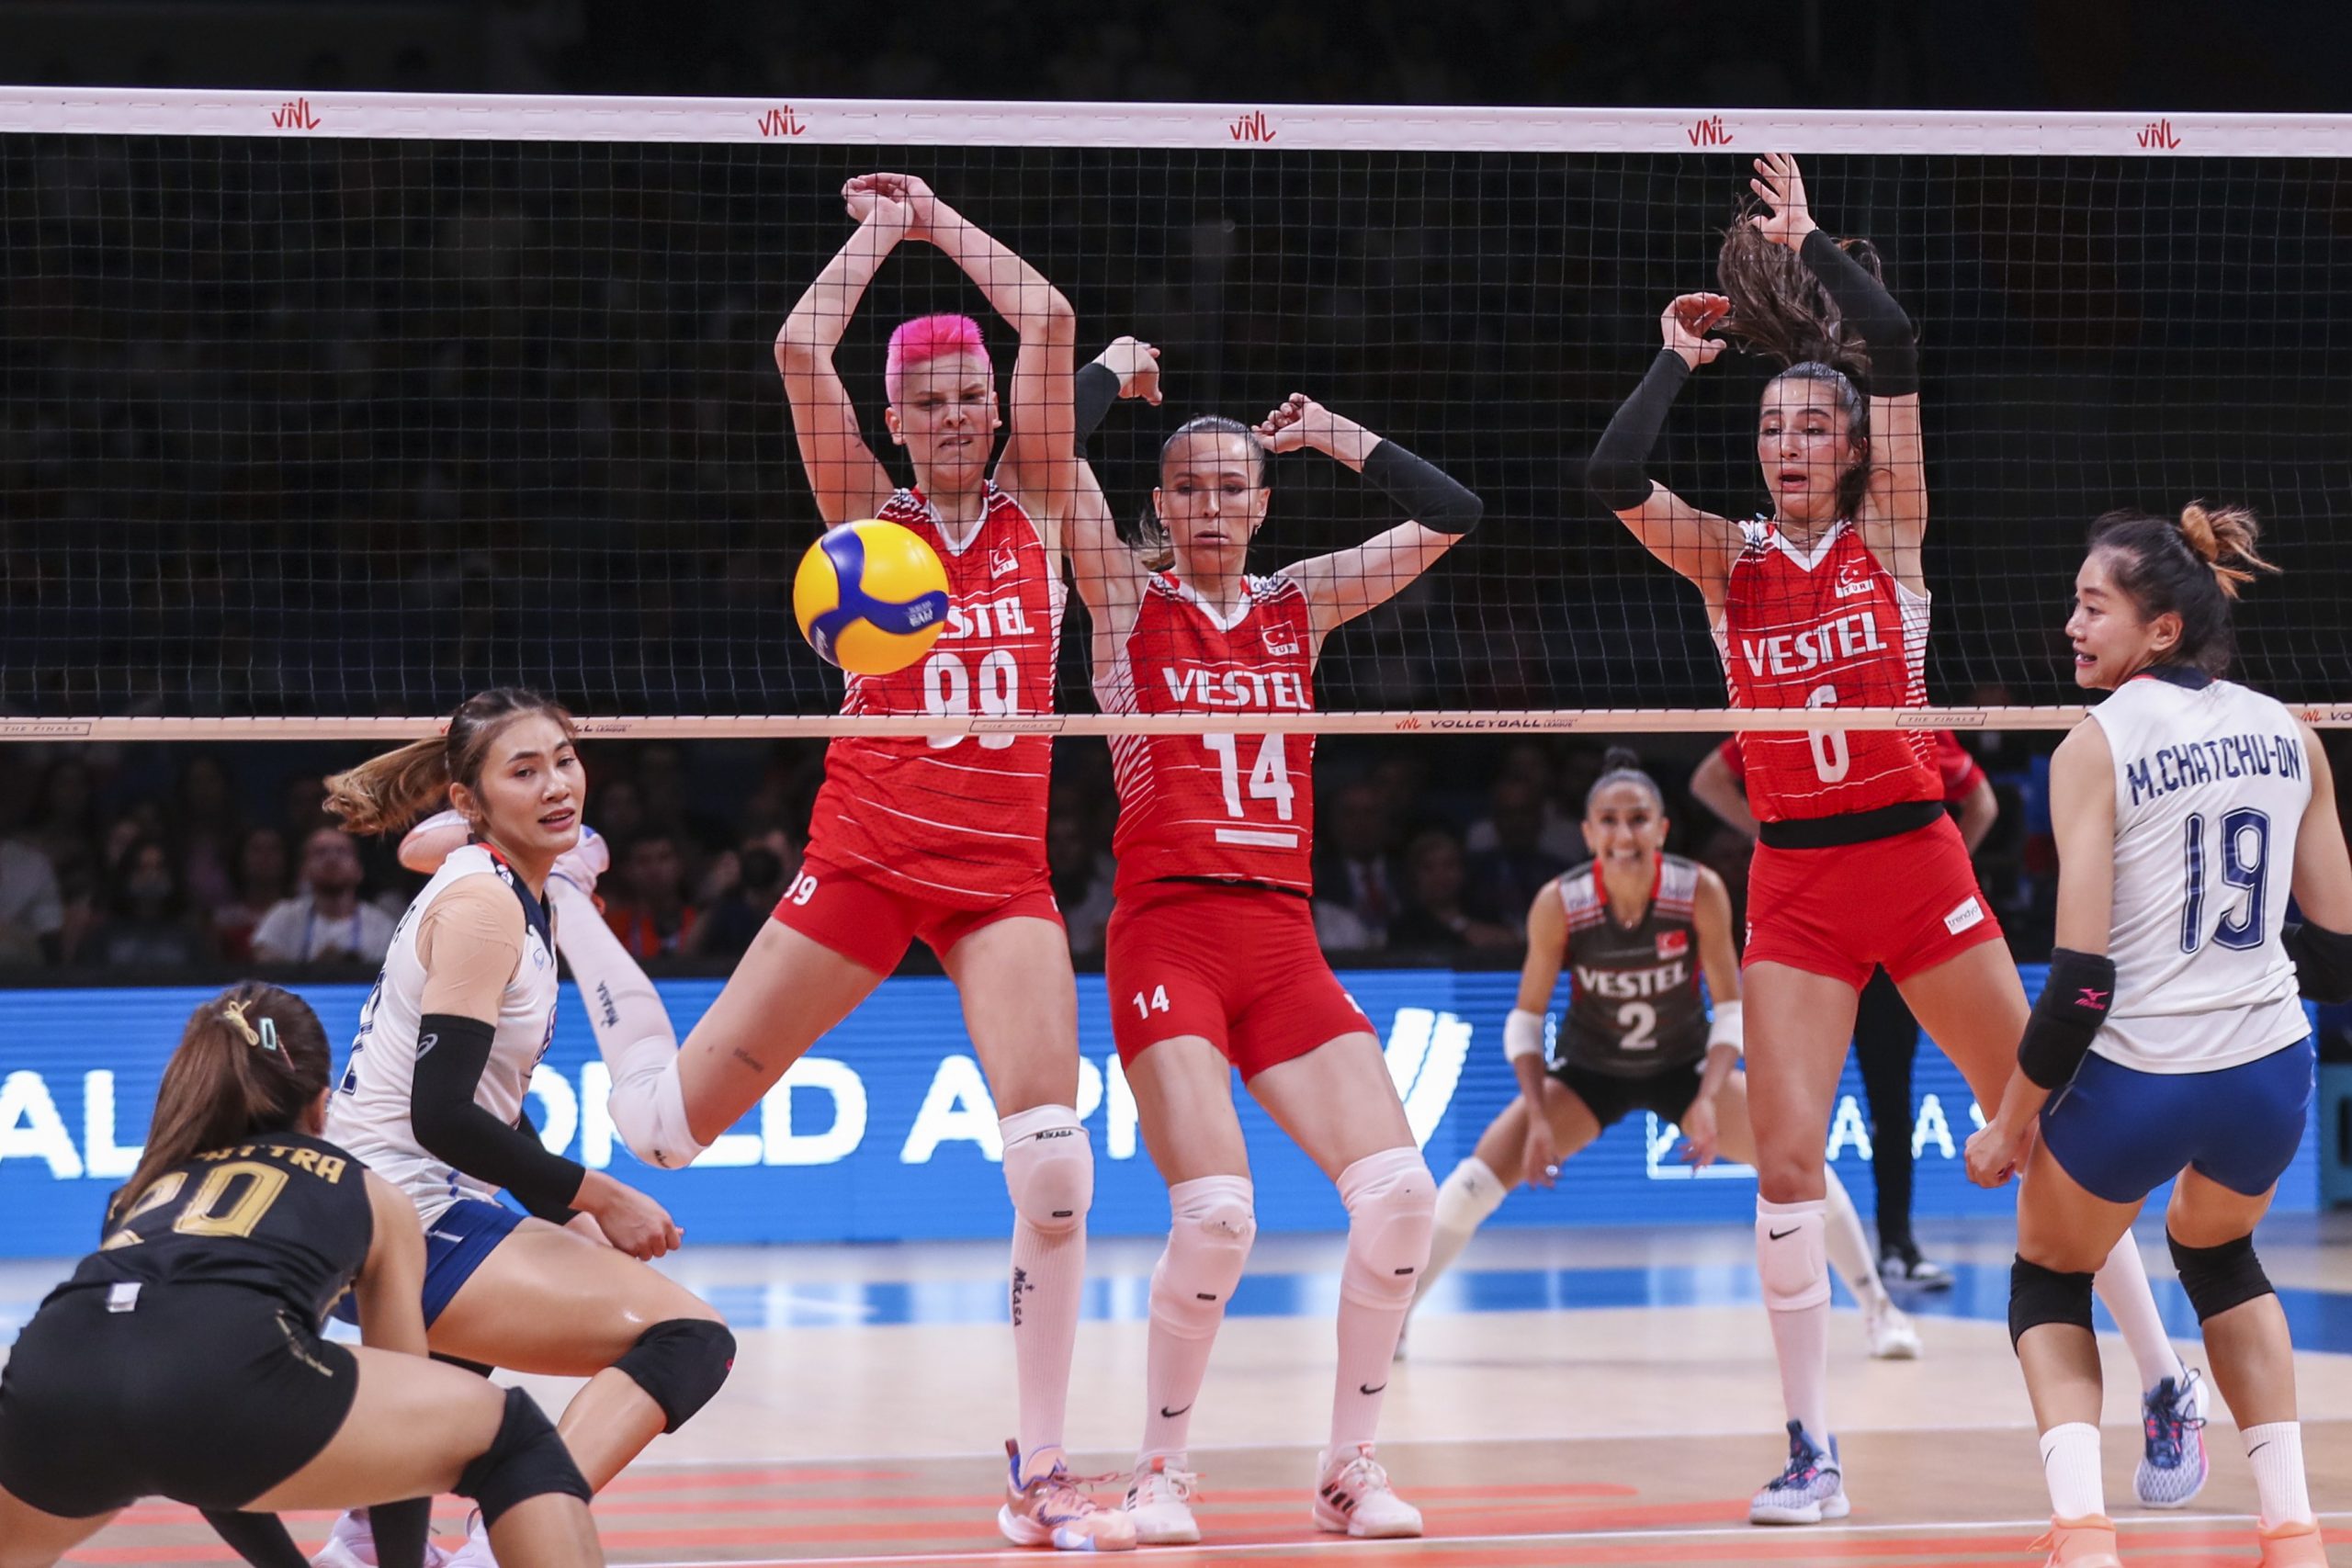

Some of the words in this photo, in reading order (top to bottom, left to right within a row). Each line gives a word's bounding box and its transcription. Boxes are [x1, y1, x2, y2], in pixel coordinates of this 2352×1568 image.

[272, 97, 321, 130] VNL
[758, 105, 806, 136] VNL
[1229, 110, 1276, 141] VNL
[1688, 115, 1733, 146] VNL
[2137, 118, 2181, 149] VNL
[938, 596, 1035, 639] STEL
[1743, 612, 1887, 676] VESTEL
[1162, 667, 1311, 710] VESTEL
[1396, 717, 1421, 729] VNL
[1430, 719, 1541, 728] VOLLEYBALL
[1804, 684, 1850, 784] 6
[1203, 733, 1295, 820] 14
[2126, 734, 2301, 806] M.CHATCHU-ON
[2180, 807, 2270, 953] 19
[1577, 961, 1689, 998] VESTEL
[1133, 984, 1170, 1020] 14
[1617, 1001, 1657, 1050] 2
